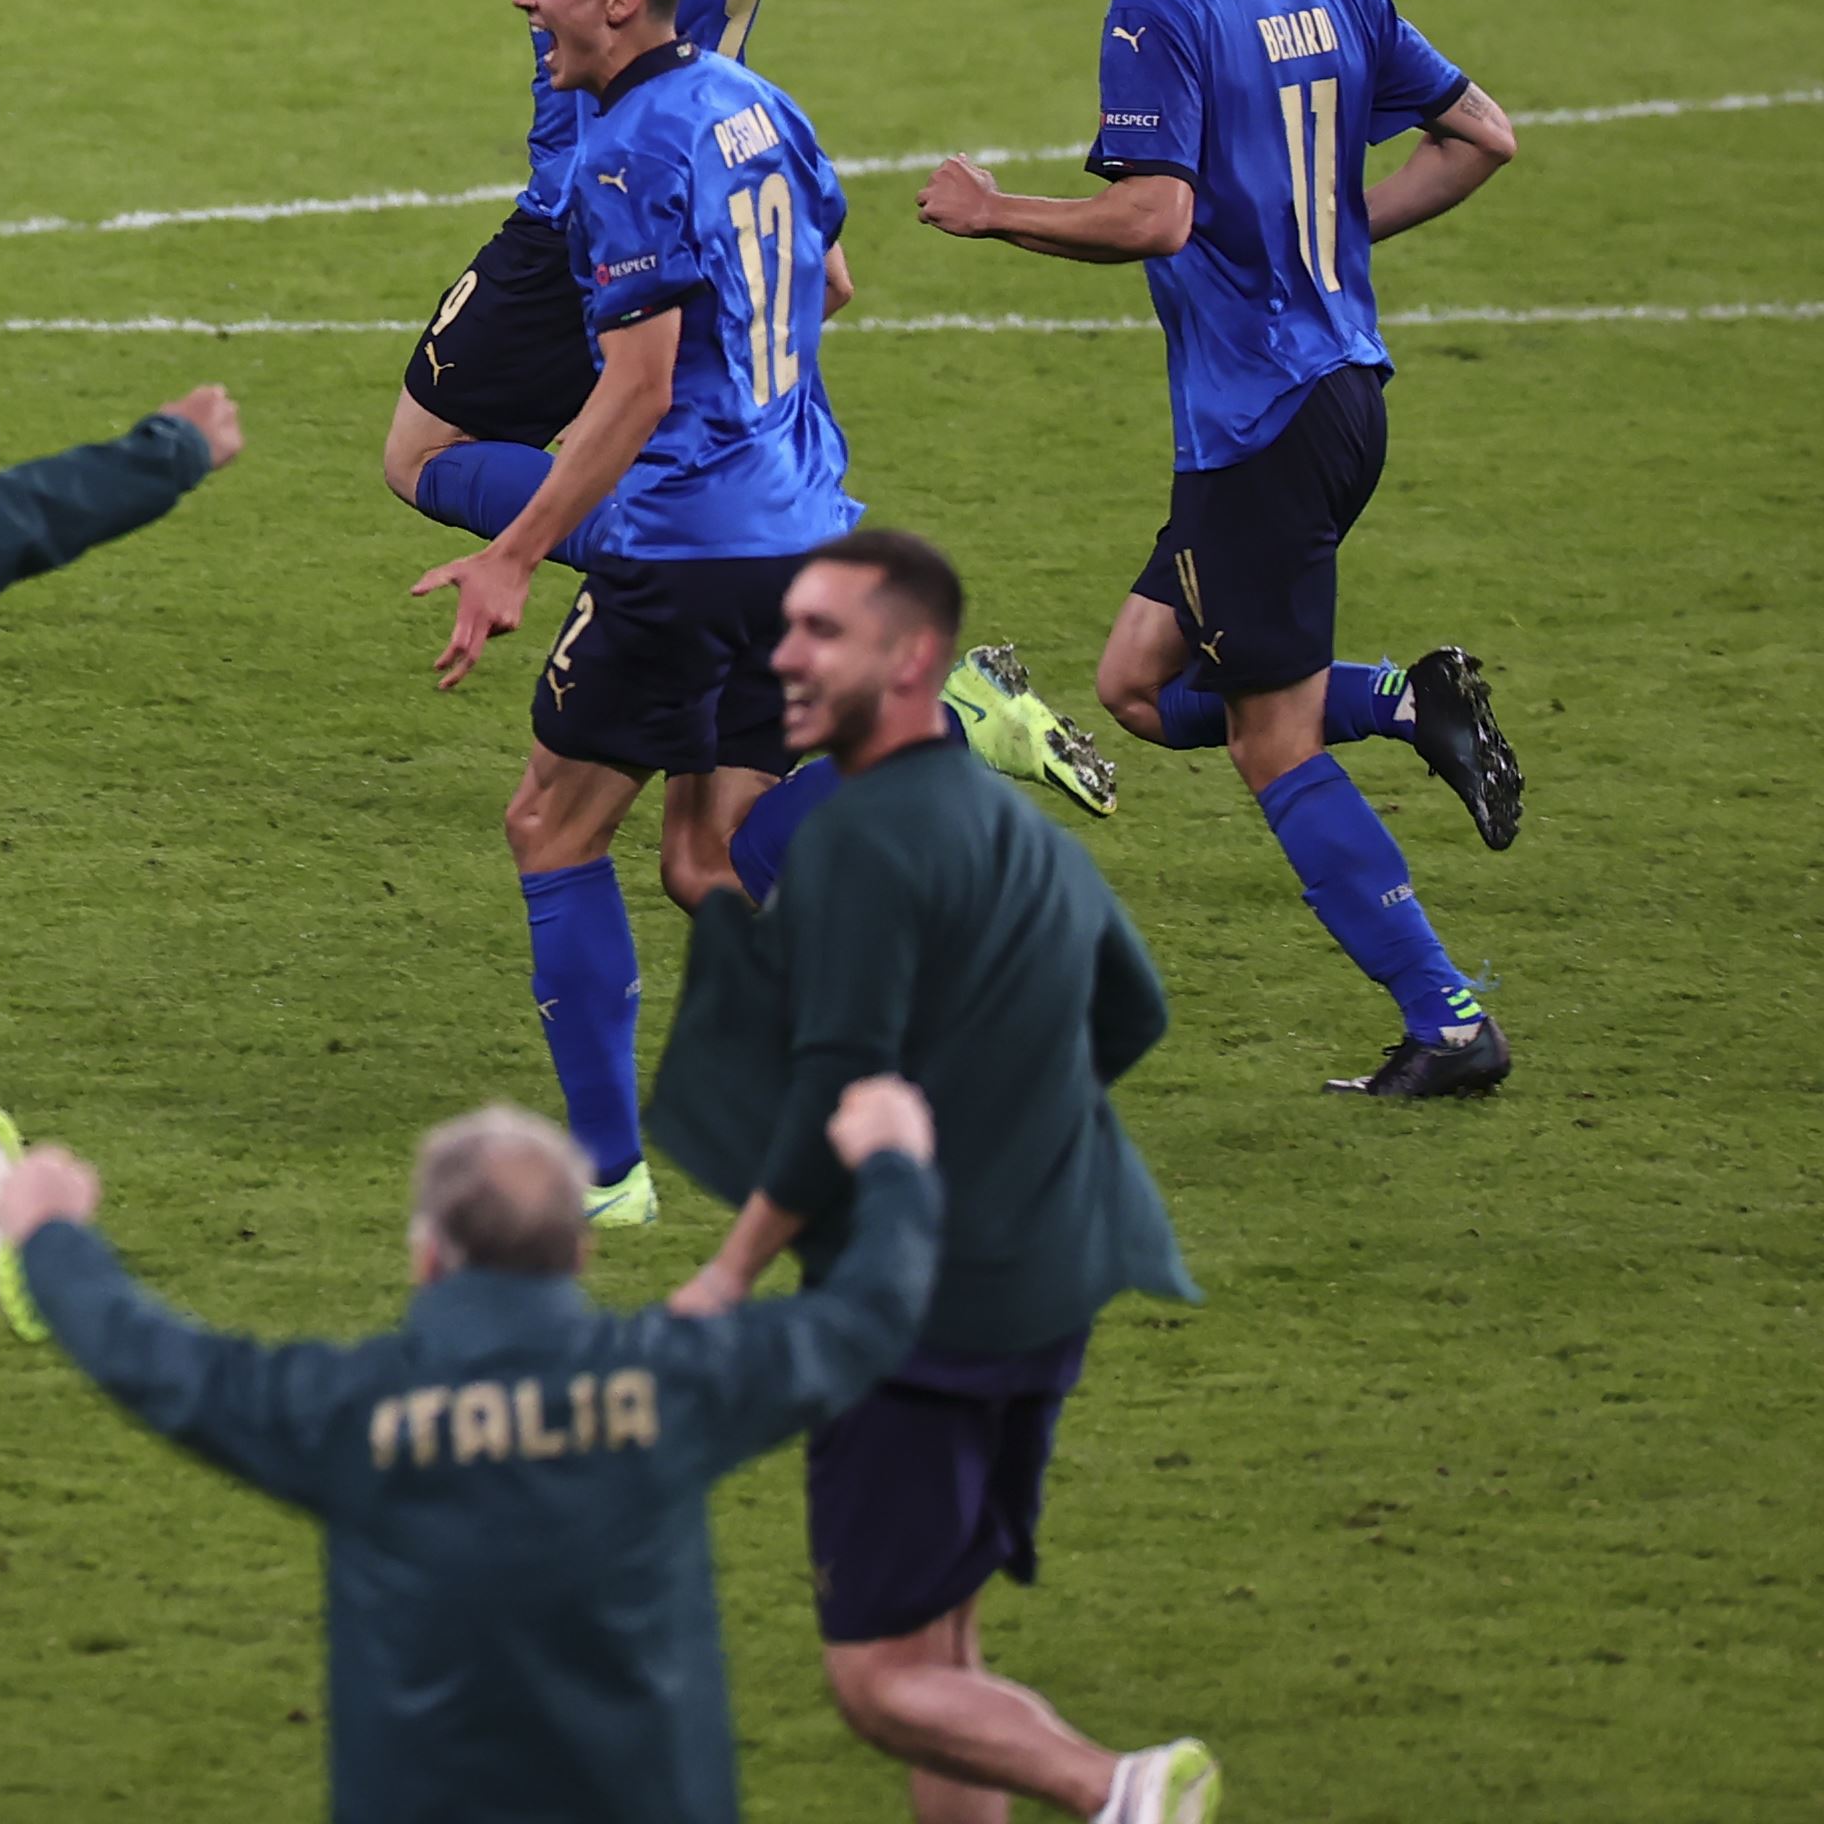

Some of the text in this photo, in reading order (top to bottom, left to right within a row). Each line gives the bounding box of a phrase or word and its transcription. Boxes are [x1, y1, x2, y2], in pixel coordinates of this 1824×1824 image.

[1256, 6, 1339, 63] BERARDI
[1105, 113, 1160, 126] RESPECT
[1278, 76, 1342, 293] 11
[431, 269, 479, 336] 9
[727, 173, 800, 407] 12
[369, 1366, 660, 1470] ITALIA
